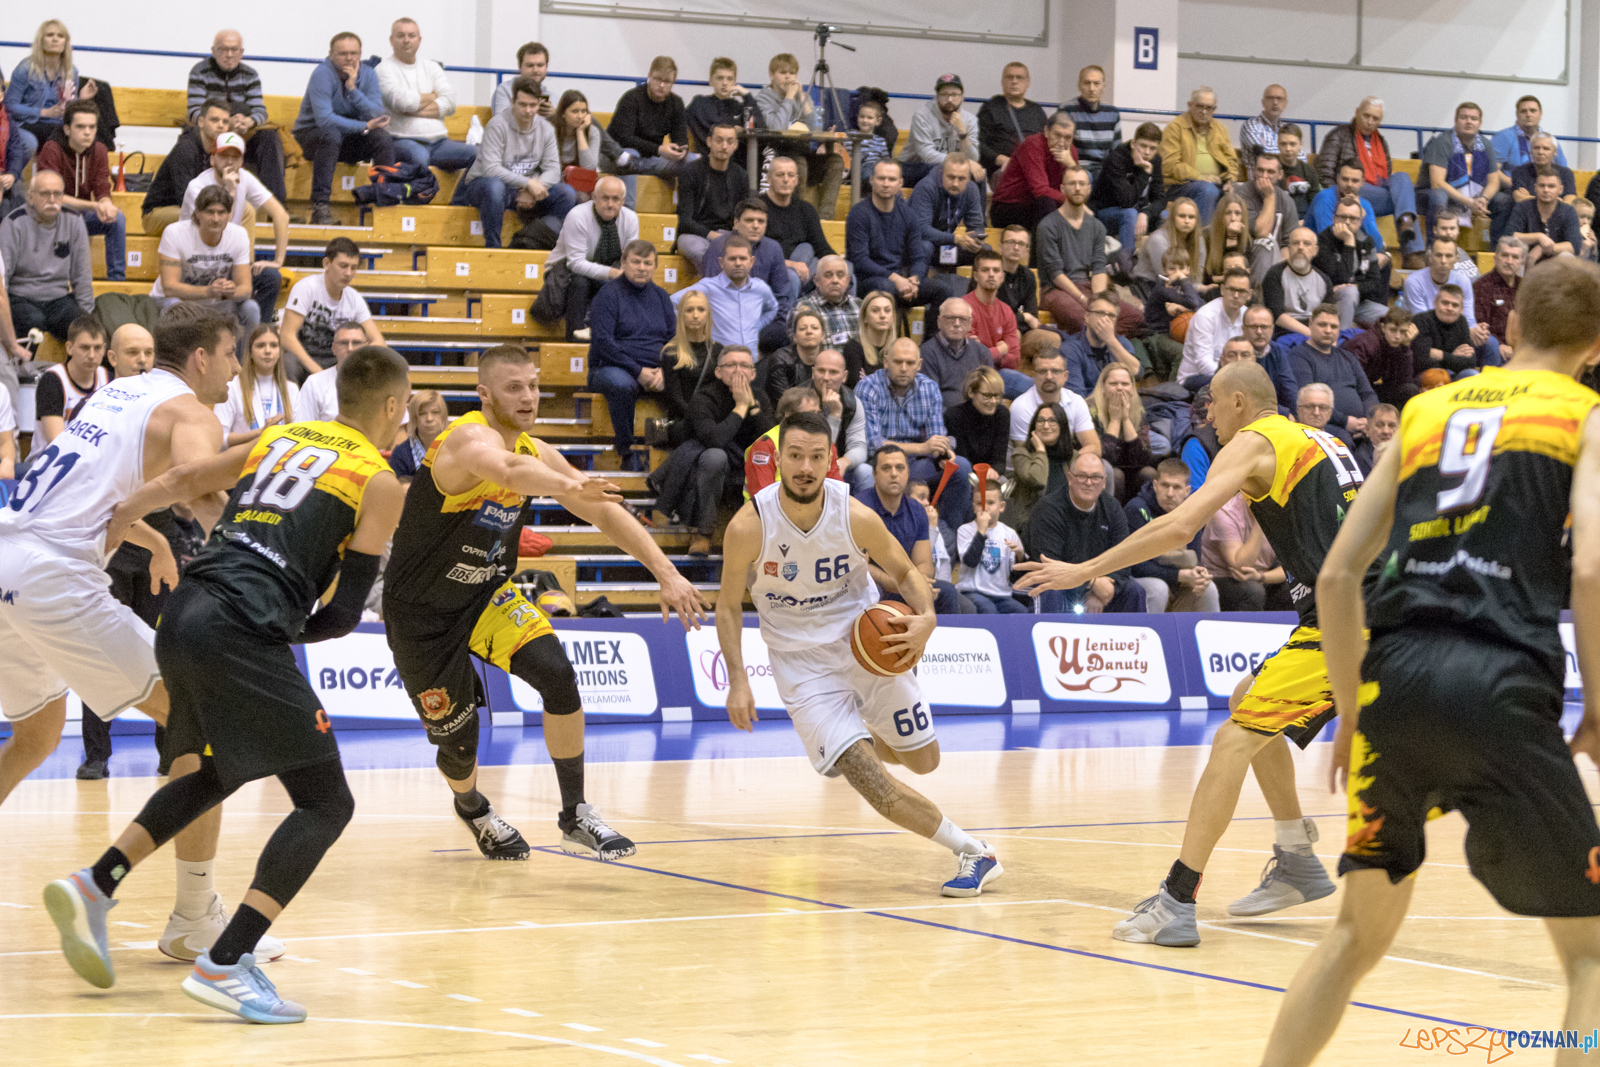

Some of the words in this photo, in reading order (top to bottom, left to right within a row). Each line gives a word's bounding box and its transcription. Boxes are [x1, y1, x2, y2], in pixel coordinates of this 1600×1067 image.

[1138, 33, 1155, 63] B
[131, 254, 138, 262] 10
[65, 420, 108, 448] AREK
[1436, 405, 1508, 514] 9
[9, 444, 81, 513] 31
[238, 436, 339, 512] 18
[250, 542, 287, 569] Polska
[815, 554, 851, 584] 66
[508, 603, 540, 628] 25
[921, 652, 991, 663] DIAGNOSTYKA
[1085, 637, 1140, 655] leniwej
[922, 664, 993, 675] OBRAZOWA
[1086, 653, 1148, 674] Danuty
[893, 701, 929, 737] 66
